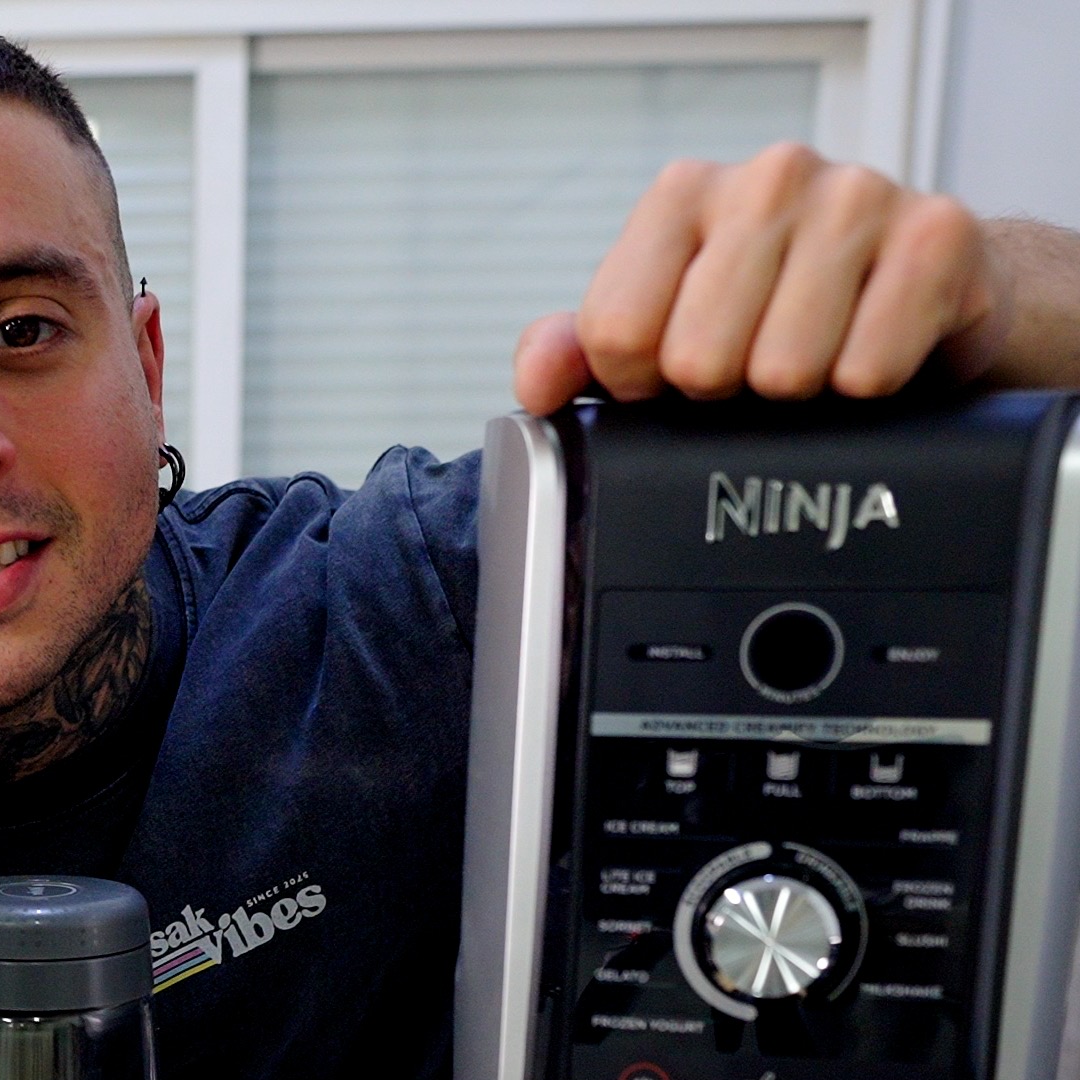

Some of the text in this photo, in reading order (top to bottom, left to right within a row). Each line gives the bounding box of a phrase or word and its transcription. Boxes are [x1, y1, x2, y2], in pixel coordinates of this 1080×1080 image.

[706, 471, 900, 550] NINJA
[664, 779, 697, 794] TOP
[630, 820, 680, 836] CREAM
[246, 885, 280, 908] SINCE
[591, 1014, 704, 1034] FROZEN YOGURT
